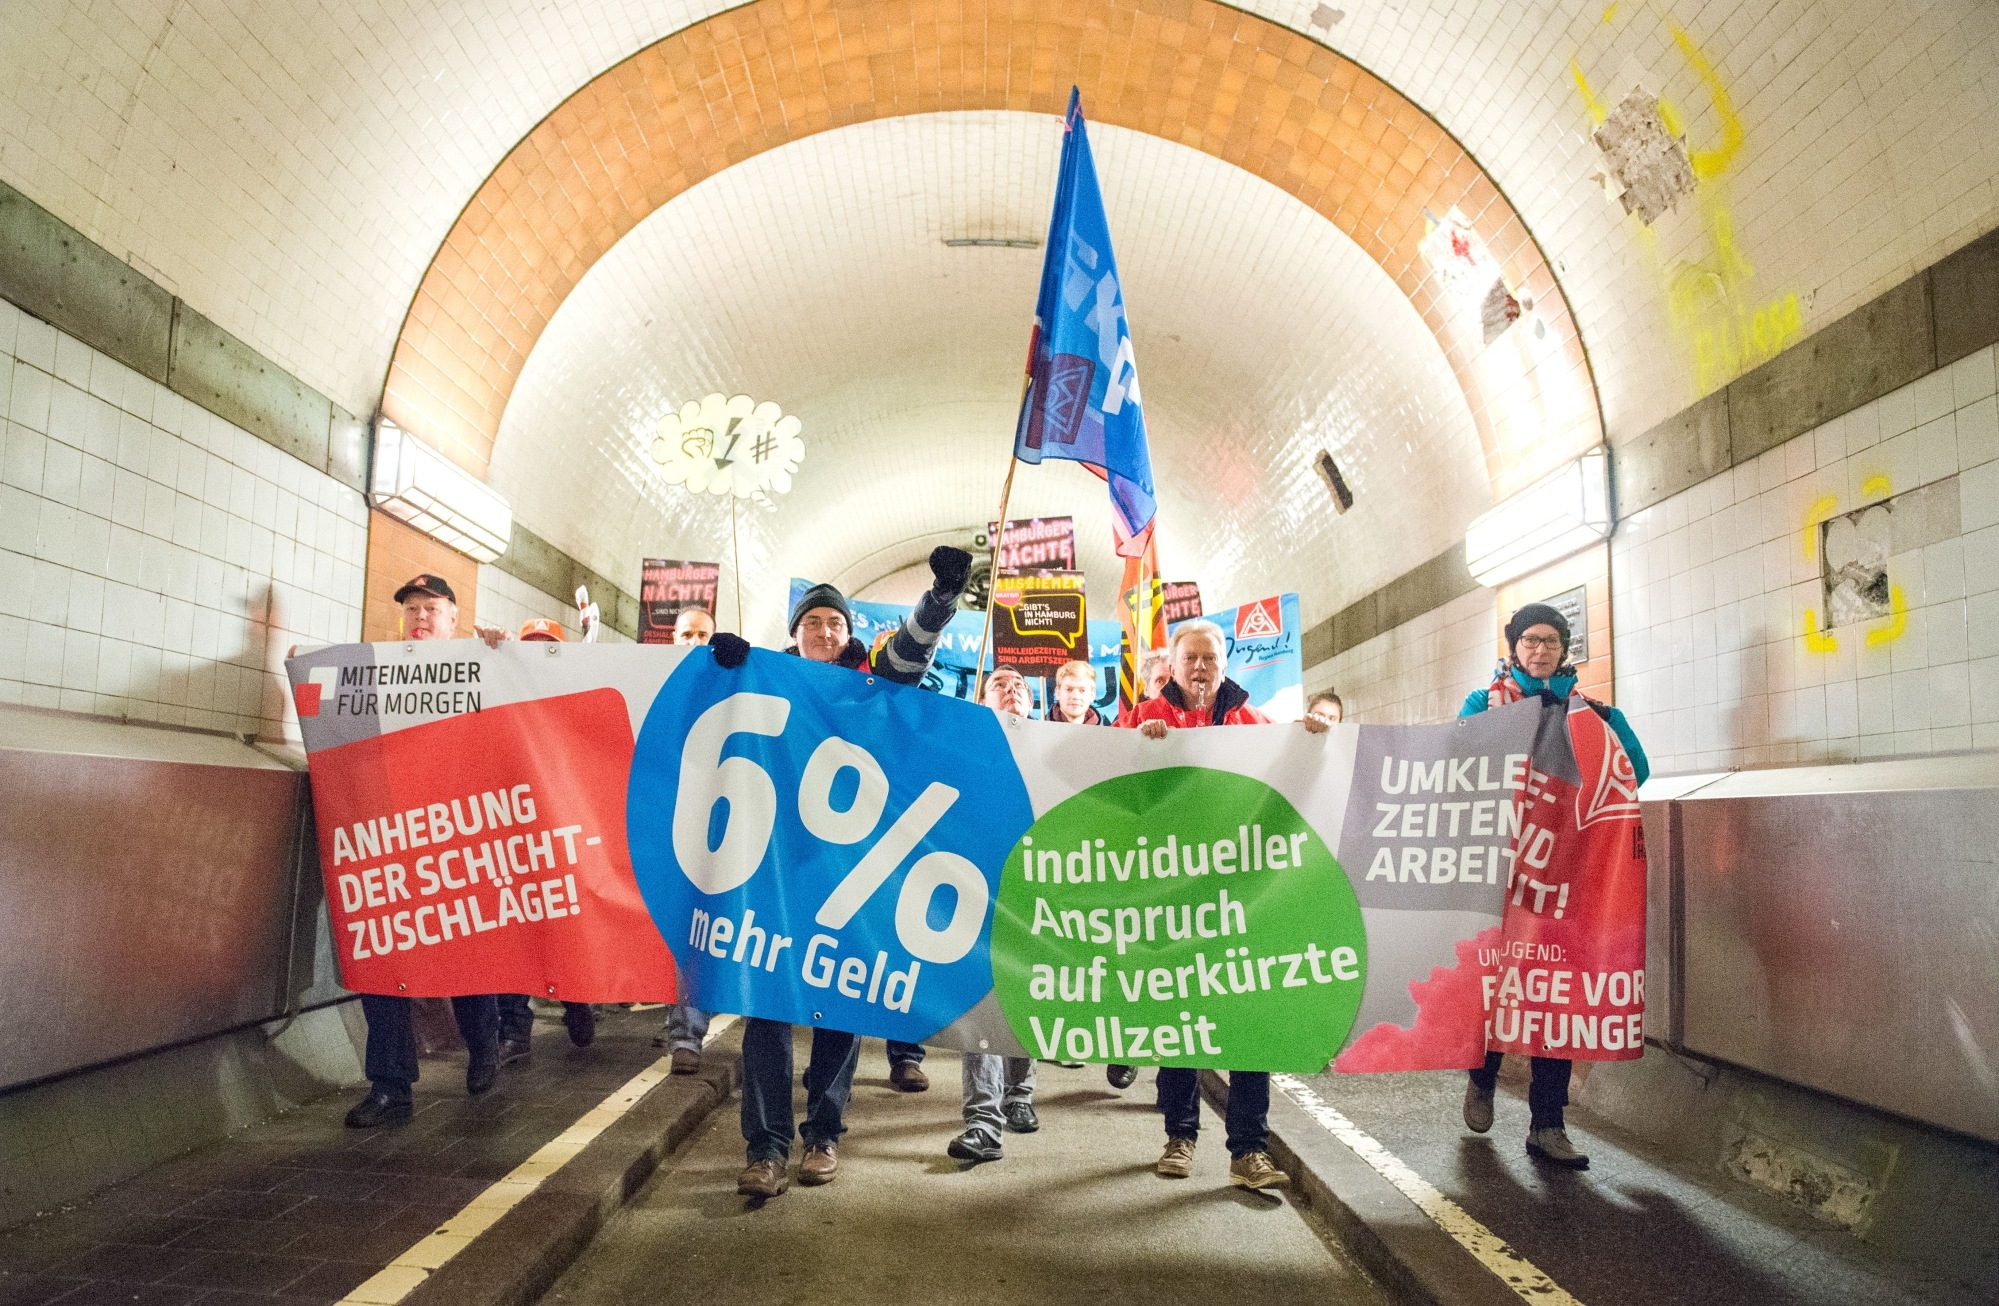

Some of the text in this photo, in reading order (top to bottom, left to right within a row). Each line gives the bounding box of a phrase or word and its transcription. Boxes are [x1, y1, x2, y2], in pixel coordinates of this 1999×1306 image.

[643, 581, 715, 600] NÄCHTE
[644, 568, 716, 580] HAMBURGER
[996, 577, 1082, 590] AUSZIEHEN
[341, 661, 481, 687] MITEINANDER
[998, 647, 1067, 656] UMKLEIDEZEITEN
[337, 689, 481, 716] FÜR MORGEN
[333, 783, 537, 866] ANHEBUNG
[672, 691, 989, 964] 6%
[1372, 800, 1525, 840] ZEITEN
[338, 825, 602, 914] DER SCHICHT-
[1022, 824, 1308, 884] individueller
[347, 874, 581, 961] ZUSCHLÄGE!
[1031, 889, 1247, 955] Anspruch
[689, 907, 921, 1014] mehr Geld
[1029, 942, 1360, 1003] auf verkürzte
[1029, 1011, 1222, 1059] Vollzeit
